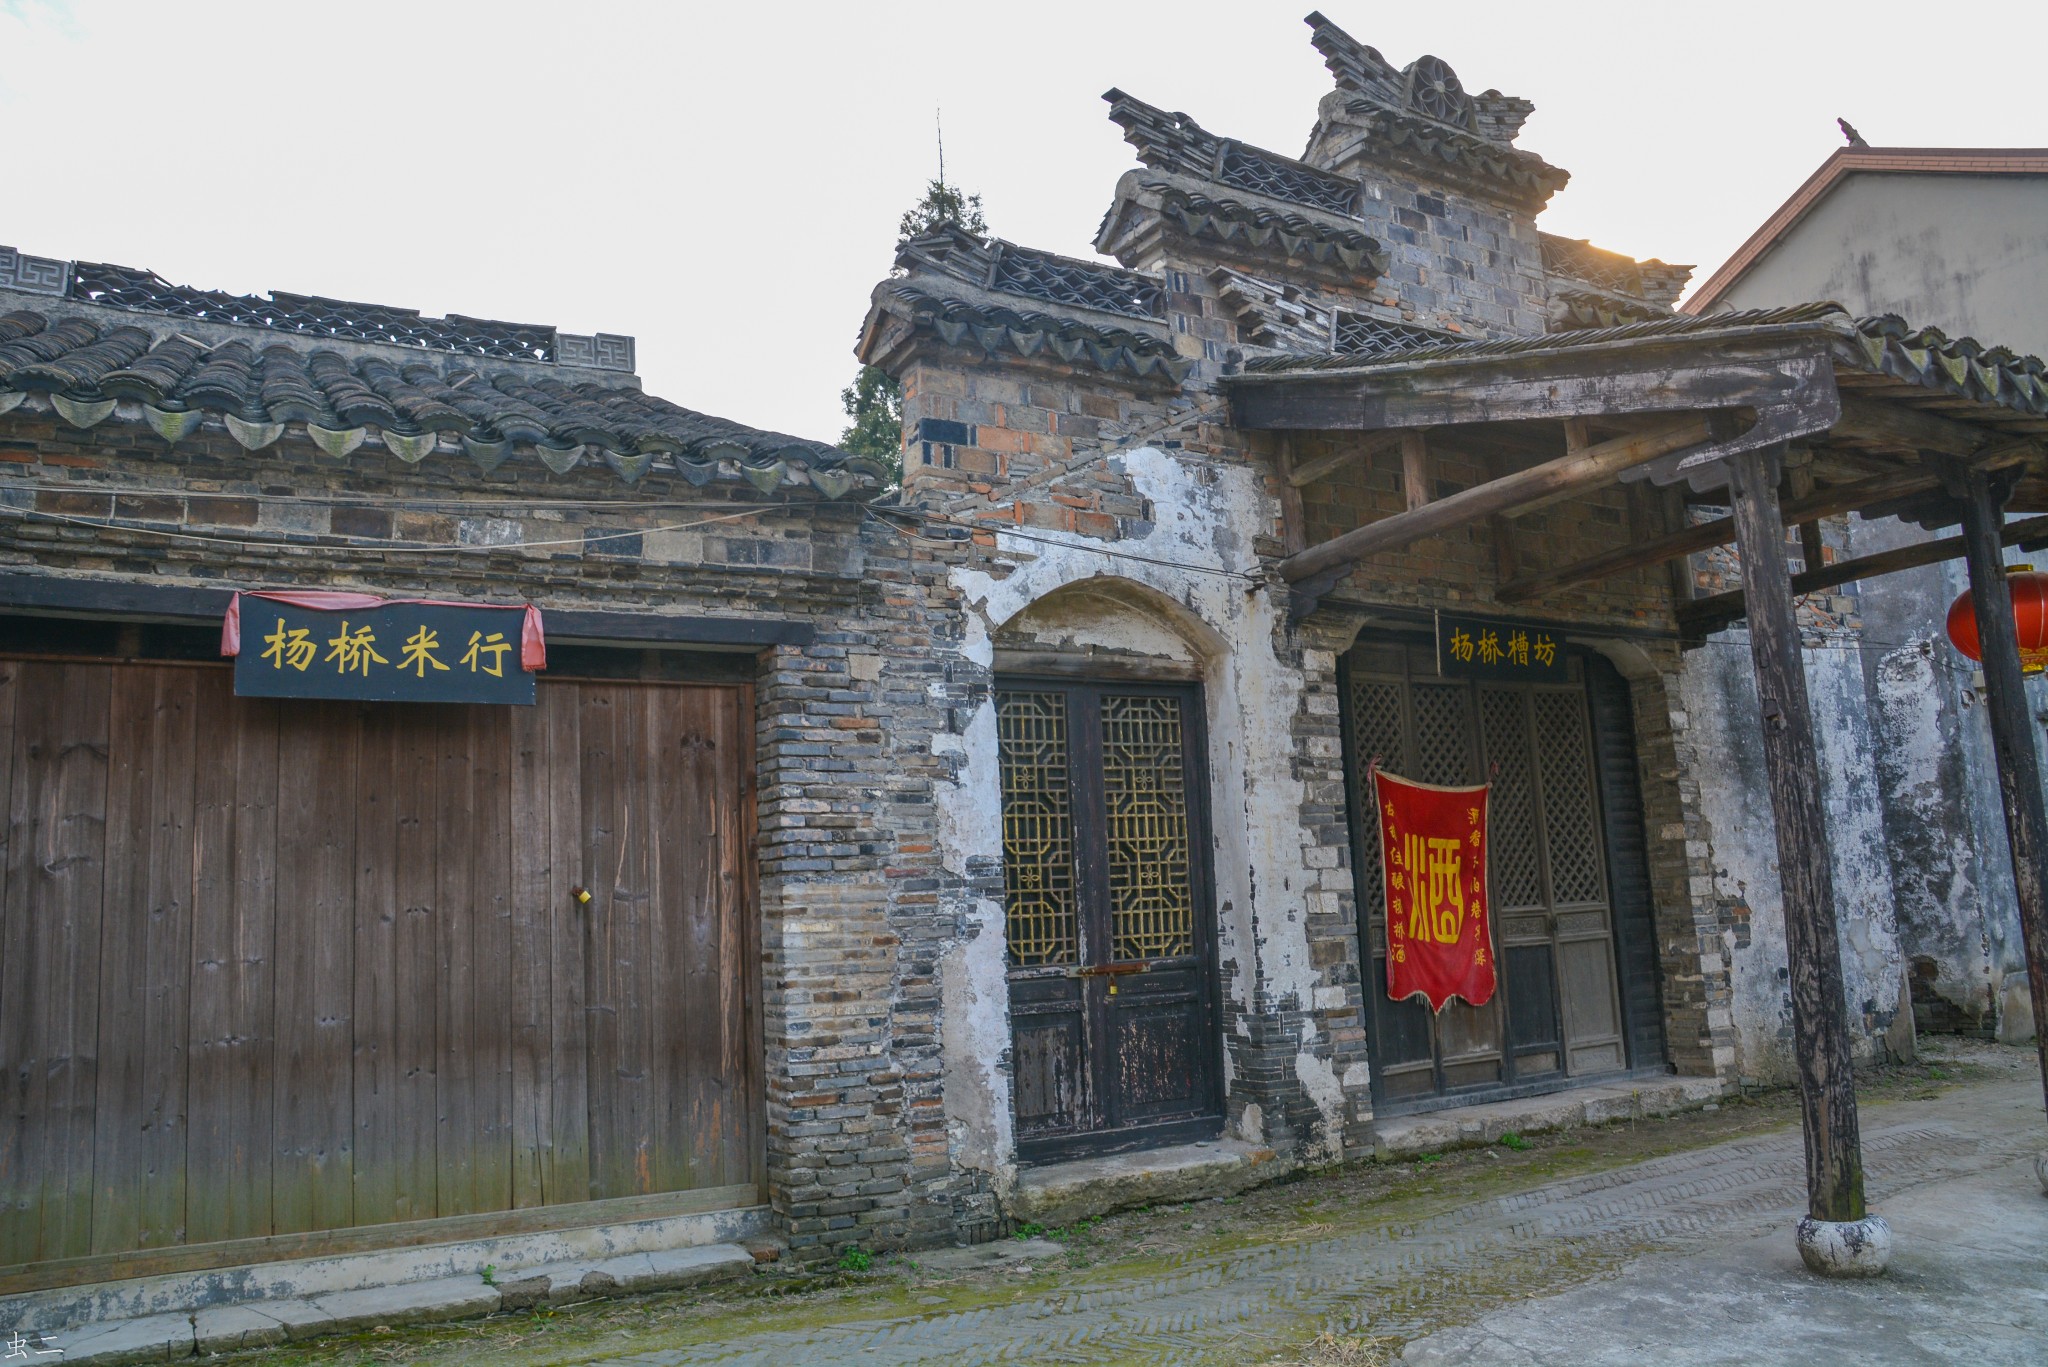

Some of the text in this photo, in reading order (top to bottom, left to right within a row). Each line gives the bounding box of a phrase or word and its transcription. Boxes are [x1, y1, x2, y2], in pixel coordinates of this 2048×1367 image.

[260, 617, 513, 678] 杨桥米行
[1450, 626, 1556, 667] 杨桥槽坊
[1404, 832, 1464, 944] 酒
